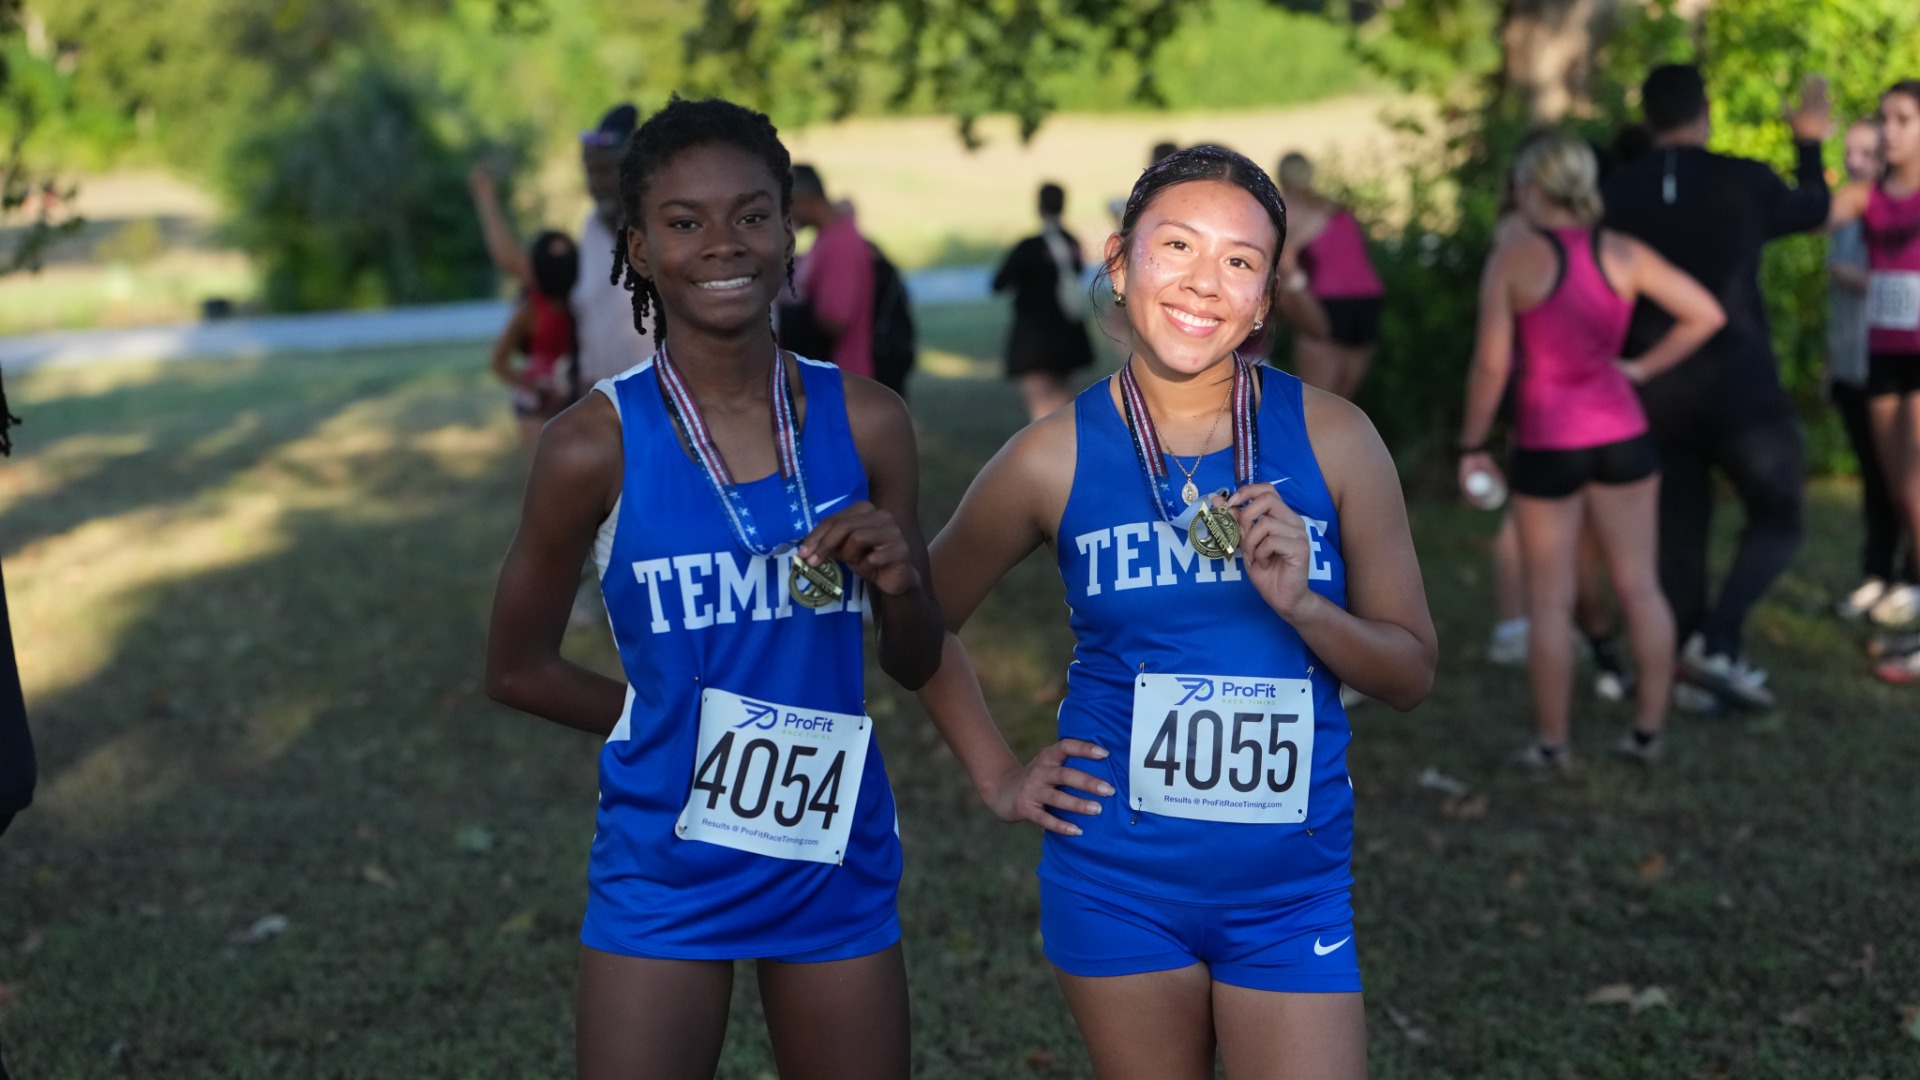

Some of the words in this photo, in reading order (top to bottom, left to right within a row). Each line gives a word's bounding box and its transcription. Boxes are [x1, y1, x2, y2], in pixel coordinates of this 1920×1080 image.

[1075, 516, 1332, 597] TEME
[632, 551, 862, 634] TEMP
[1222, 681, 1276, 698] ProFit
[784, 712, 834, 732] ProFit
[1143, 709, 1299, 793] 4055
[693, 730, 846, 830] 4054
[1164, 795, 1192, 804] Results
[1202, 798, 1283, 809] ProFitRaceTiming.com
[701, 817, 731, 831] Results
[740, 826, 819, 846] ProFitRaceTiming.com
